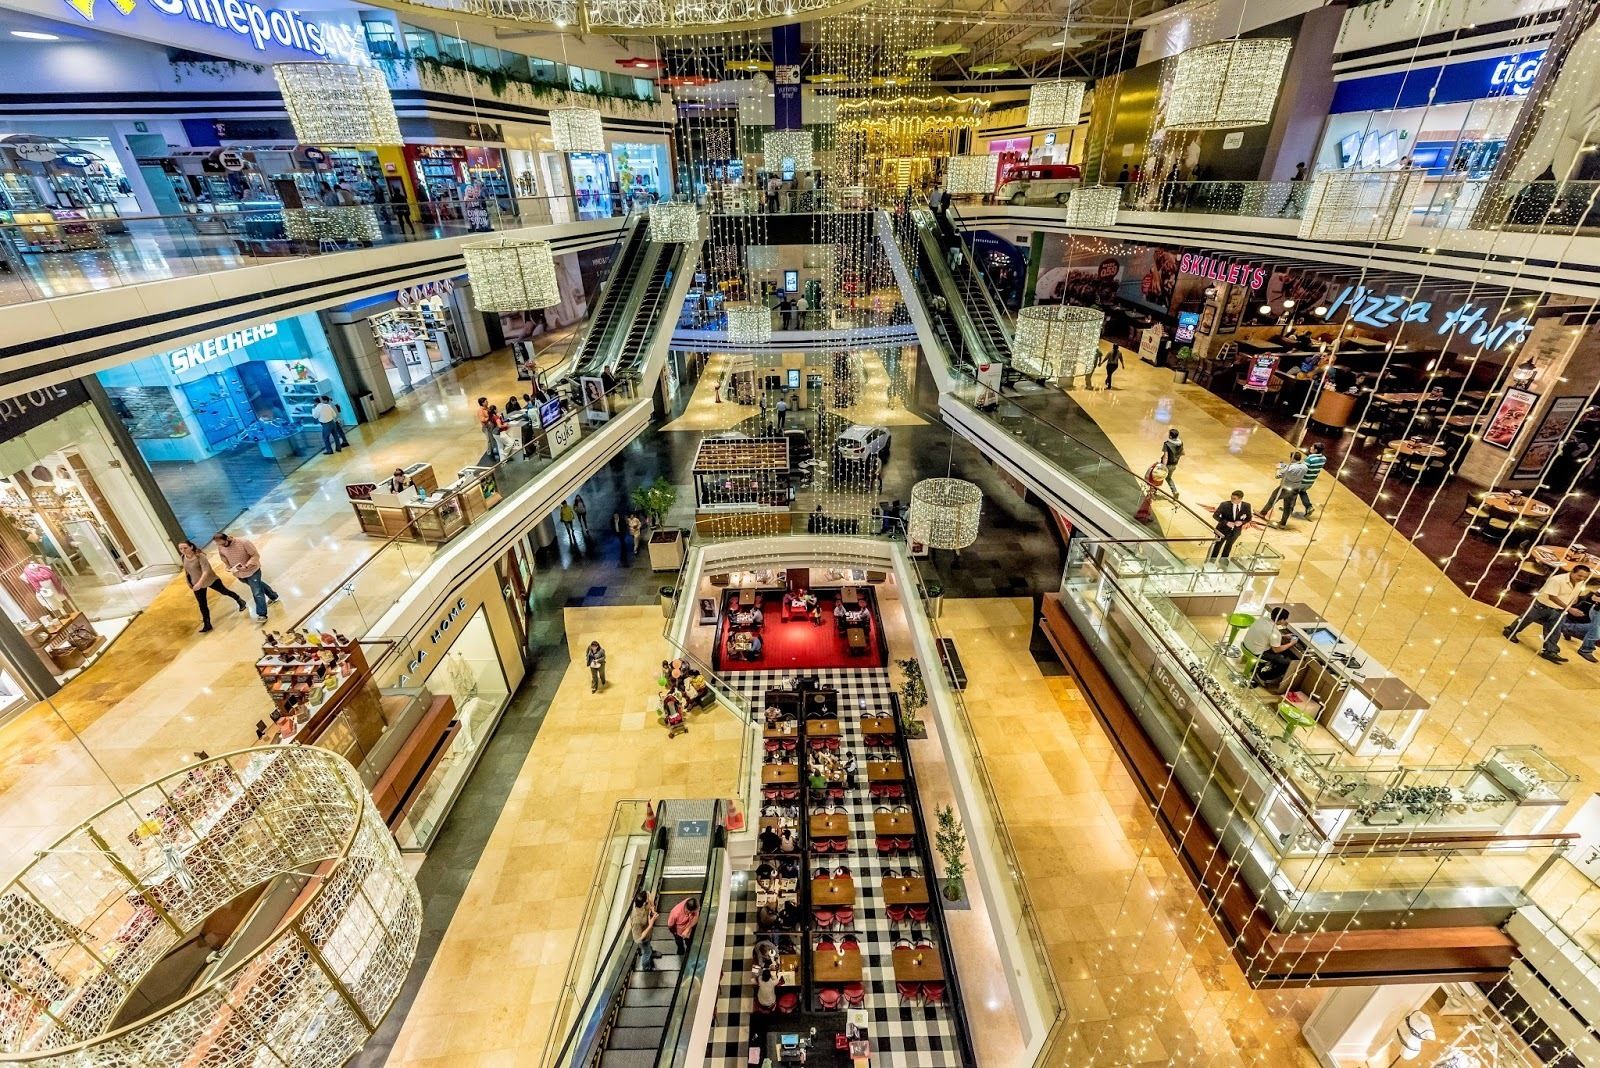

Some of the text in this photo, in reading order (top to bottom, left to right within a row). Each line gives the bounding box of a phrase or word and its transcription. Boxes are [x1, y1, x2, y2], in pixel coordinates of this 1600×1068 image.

[1490, 51, 1547, 95] tig
[1180, 253, 1266, 290] SKILLETS
[1325, 285, 1432, 328] Pizza
[1438, 303, 1534, 351] Hut
[171, 323, 278, 374] SKECHERS
[393, 597, 467, 688] ARA HOME
